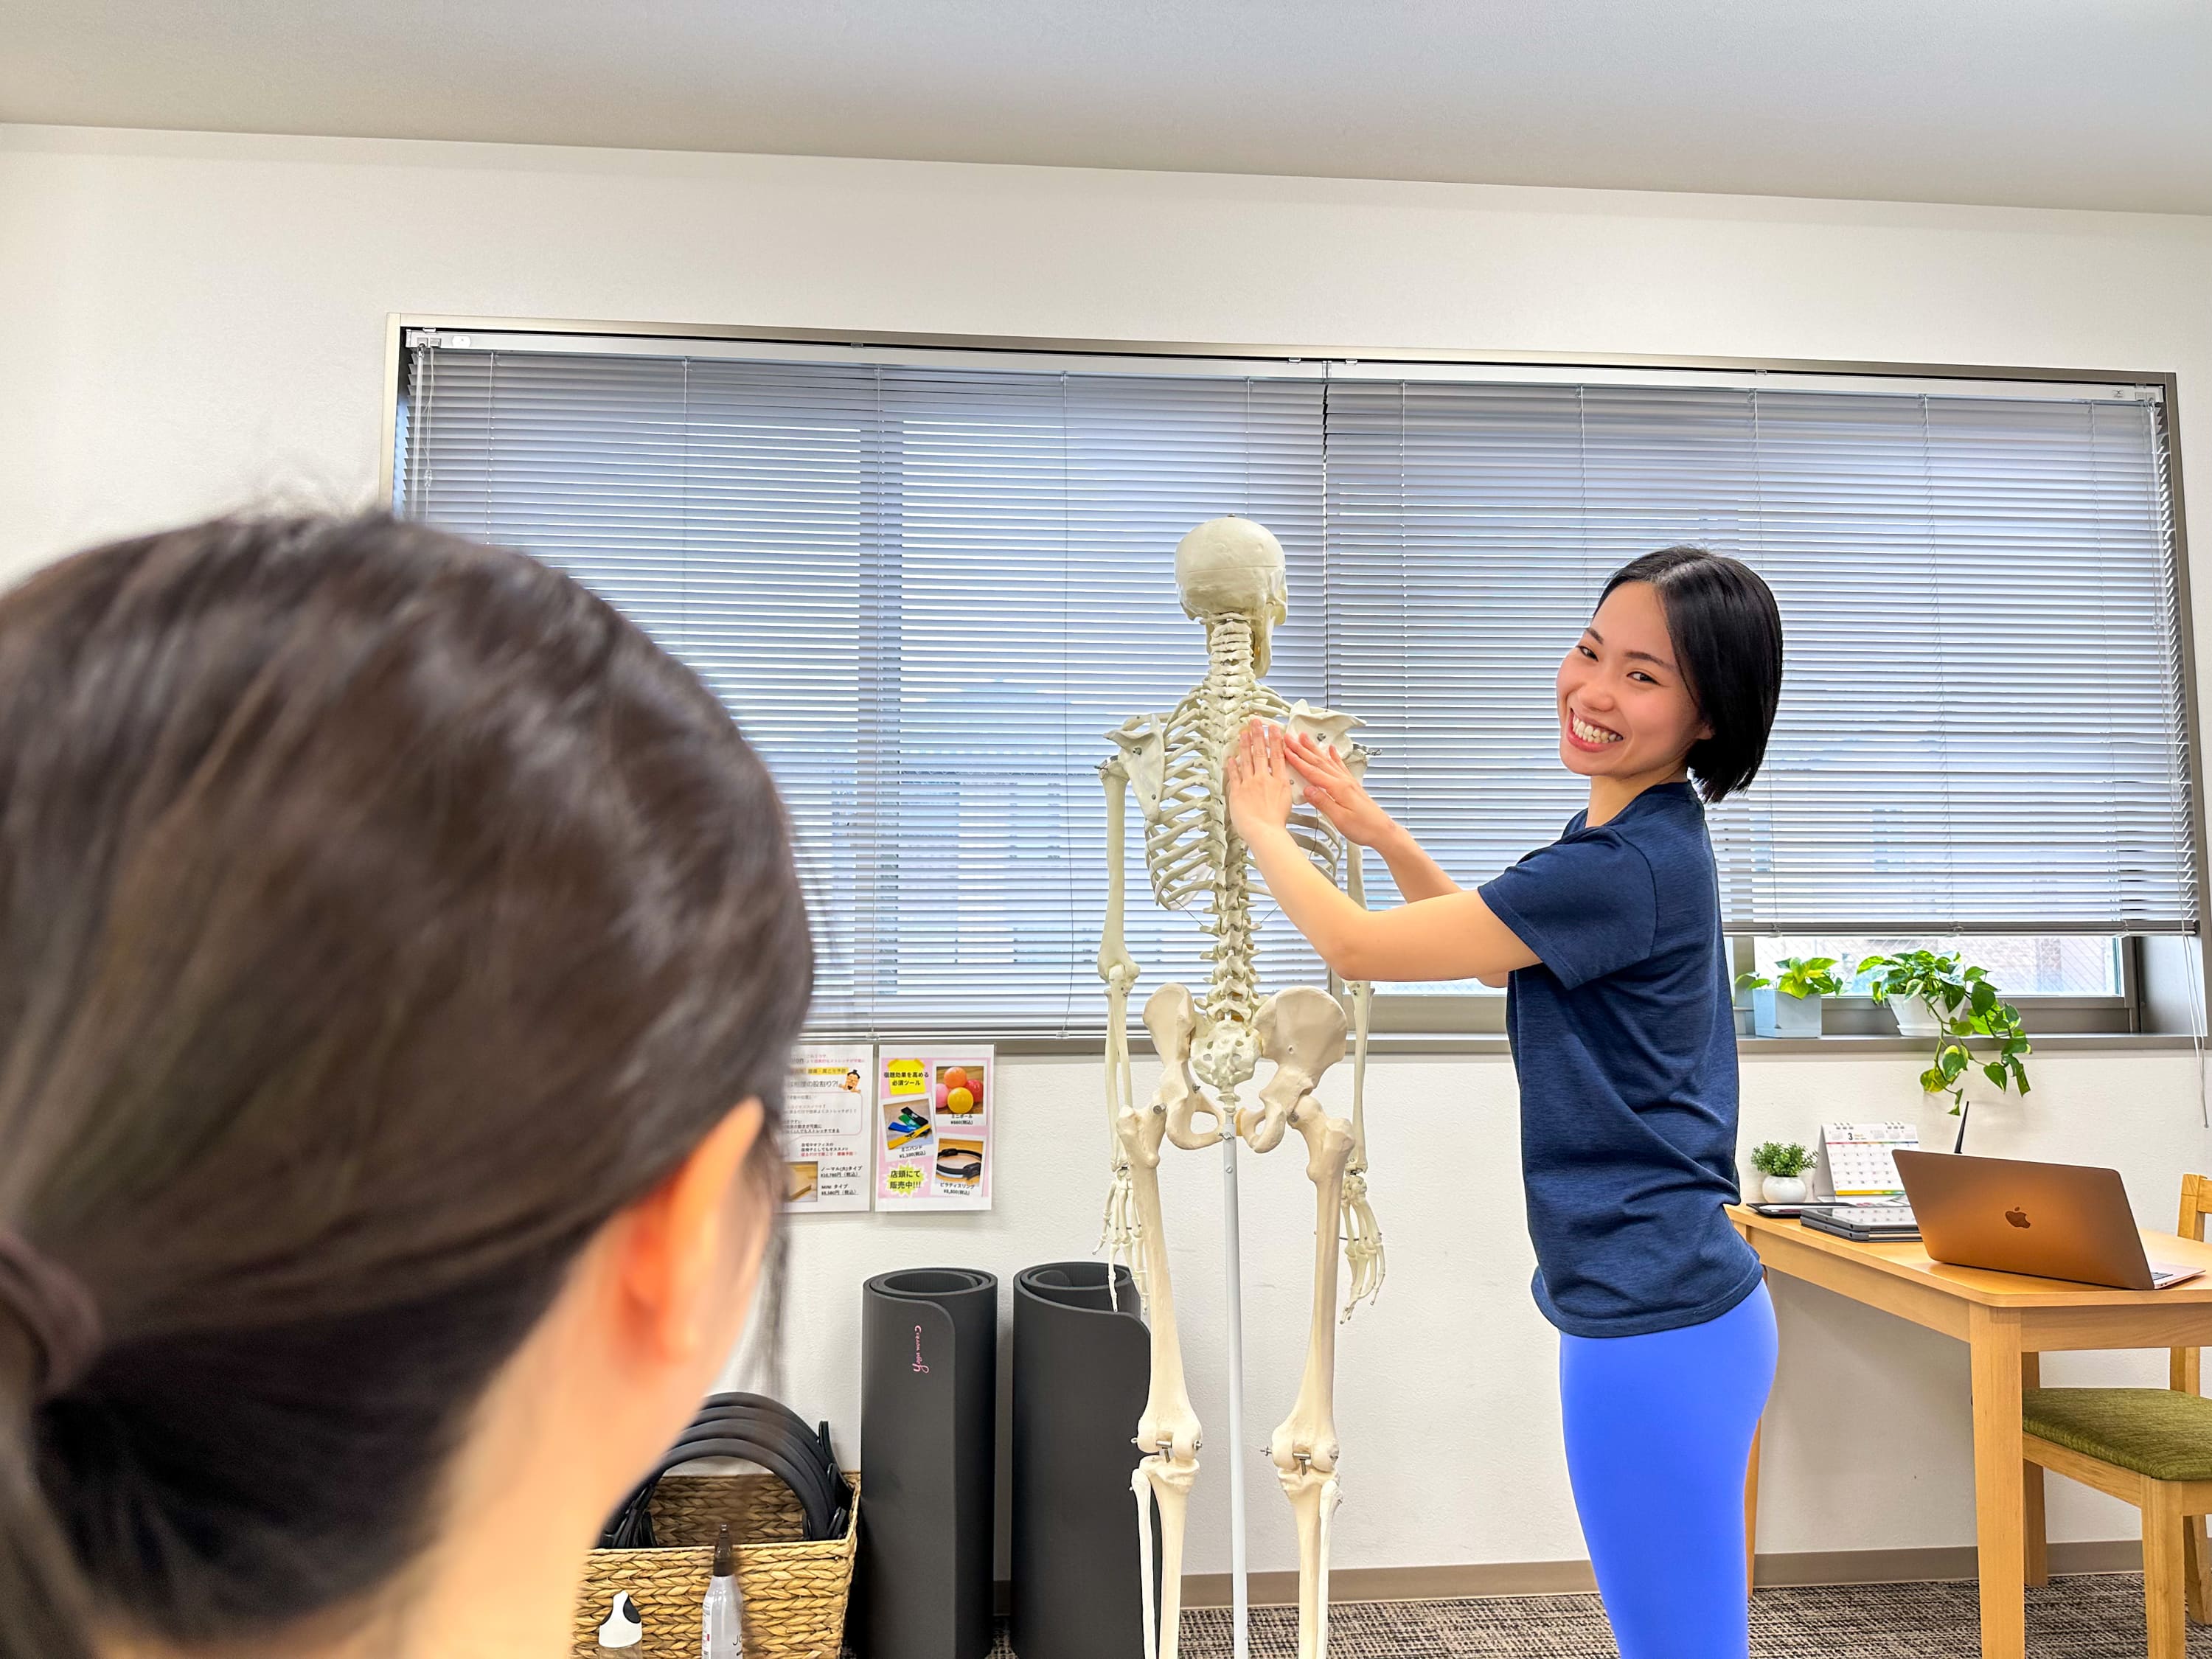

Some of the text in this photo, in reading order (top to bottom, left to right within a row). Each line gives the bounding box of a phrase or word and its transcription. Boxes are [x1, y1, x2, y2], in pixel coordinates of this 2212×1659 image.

[1848, 1133, 1853, 1141] 3
[890, 1170, 921, 1178] 店頭にて
